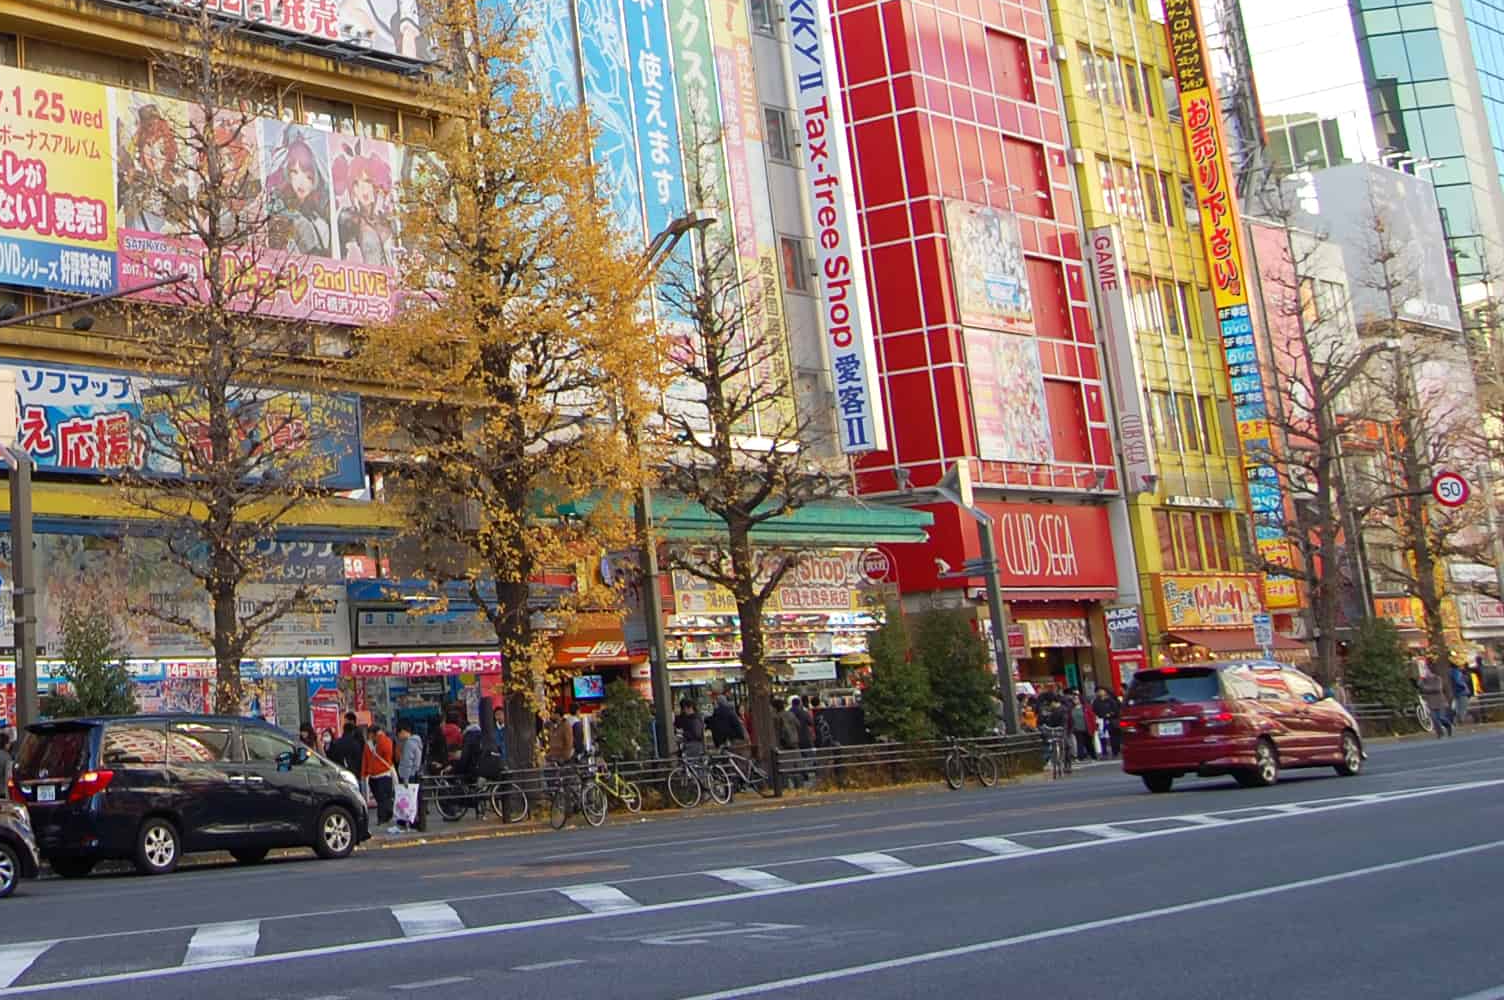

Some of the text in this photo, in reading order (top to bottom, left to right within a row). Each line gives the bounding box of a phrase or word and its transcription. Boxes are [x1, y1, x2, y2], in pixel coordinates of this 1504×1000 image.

[69, 109, 104, 130] wed
[803, 96, 842, 249] Tax-free
[53, 197, 105, 237] 発売!
[312, 265, 389, 298] 2nd LIVE
[1093, 234, 1119, 293] GAME
[821, 256, 854, 349] Shop
[22, 368, 130, 399] ソフマップ
[1439, 481, 1461, 498] 50
[1001, 513, 1079, 577] CLUB SEGA
[798, 552, 847, 588] Shop
[590, 640, 624, 657] Hey
